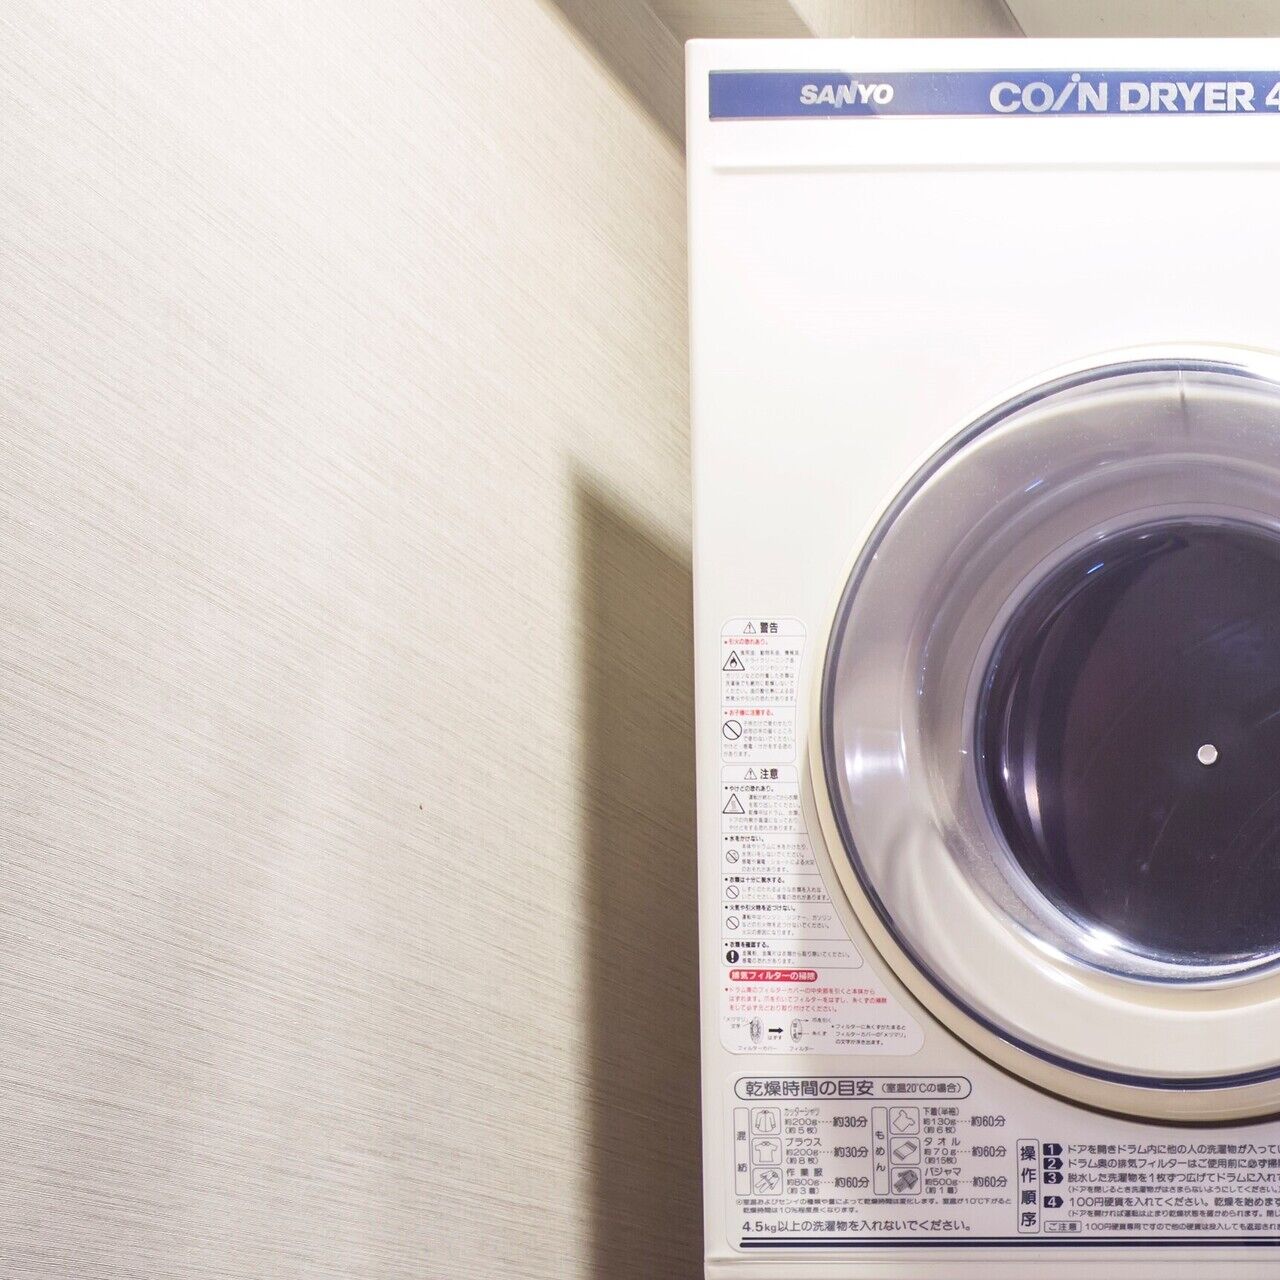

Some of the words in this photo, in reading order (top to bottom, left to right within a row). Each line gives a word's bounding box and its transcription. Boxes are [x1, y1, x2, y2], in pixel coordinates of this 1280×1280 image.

[799, 81, 894, 108] SANYO
[1120, 81, 1256, 112] DRYER
[760, 622, 778, 634] 警告
[760, 768, 778, 779] 注意
[746, 1080, 874, 1097] 乾燥時間の目安
[833, 1116, 868, 1128] 約30分
[971, 1116, 1005, 1127] 約60分
[834, 1146, 868, 1158] 約30分
[972, 1146, 1006, 1157] 約60分
[835, 1177, 869, 1188] 約60分
[973, 1176, 1007, 1188] 約60分
[1020, 1145, 1036, 1227] 操作順序
